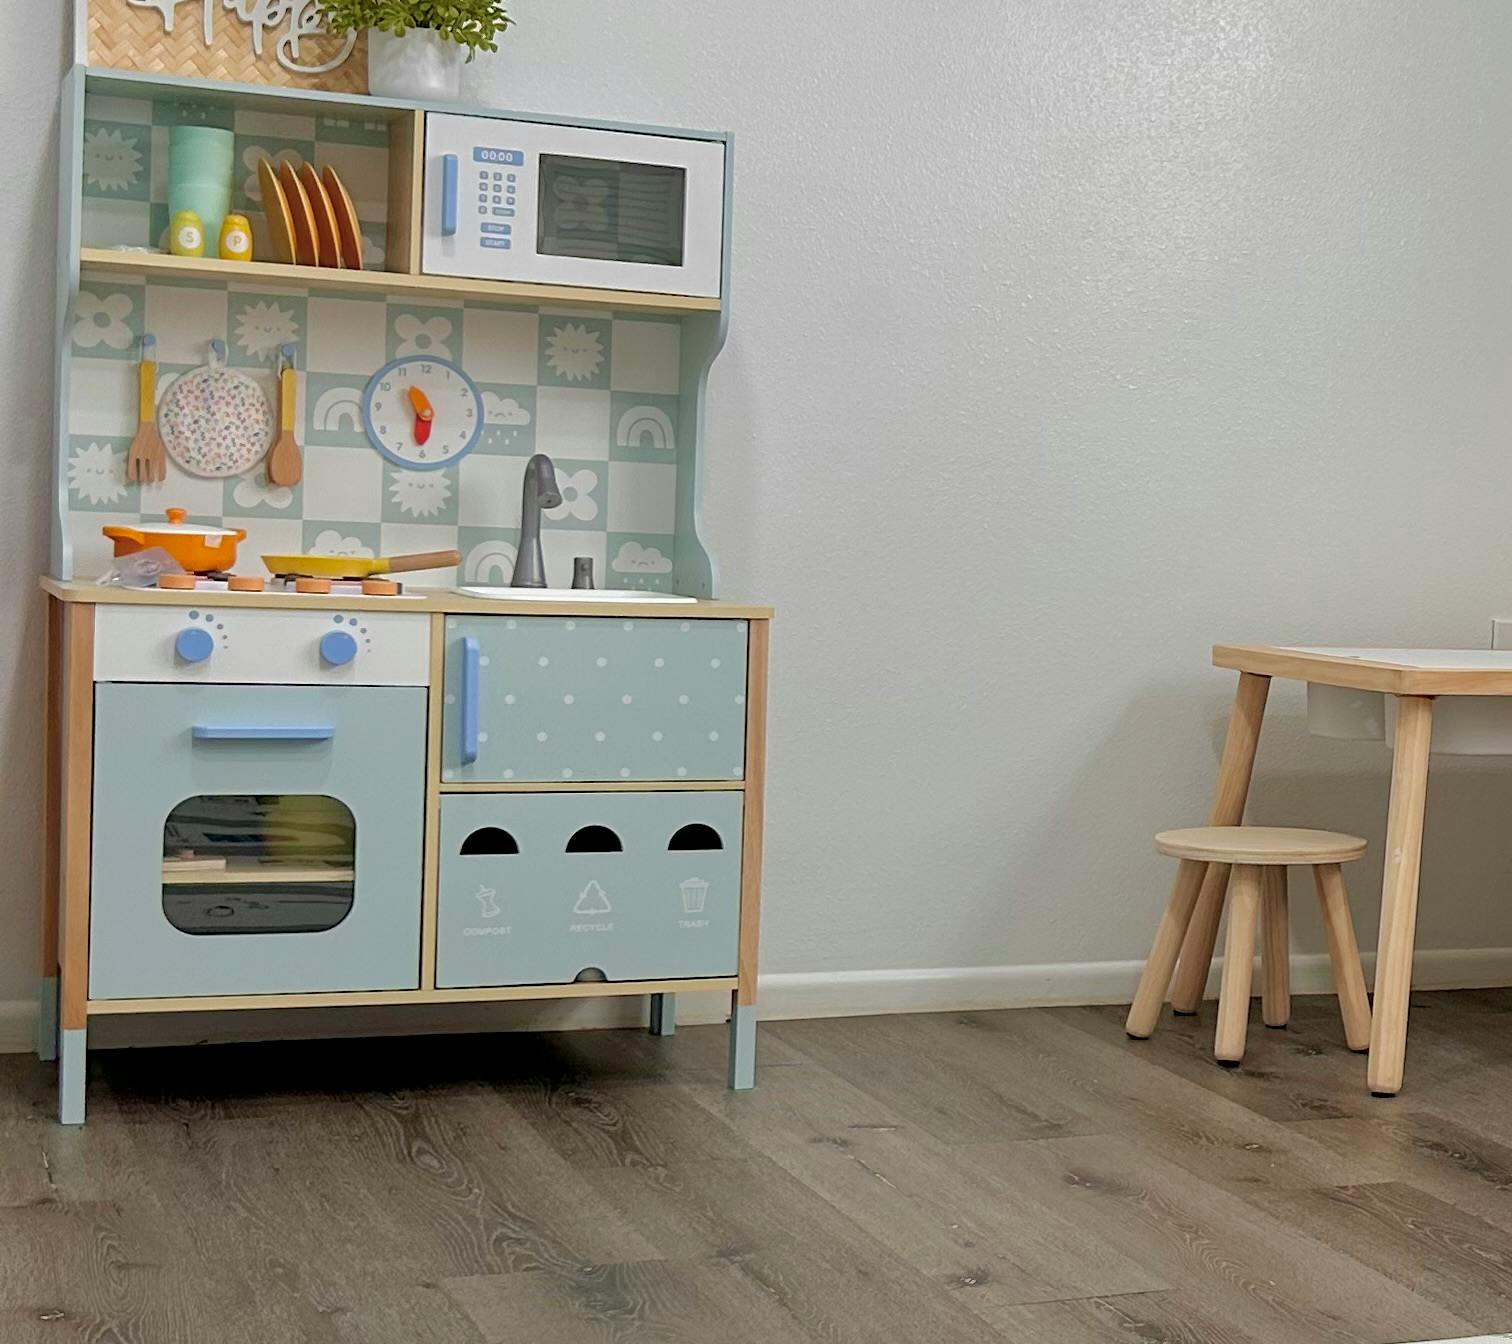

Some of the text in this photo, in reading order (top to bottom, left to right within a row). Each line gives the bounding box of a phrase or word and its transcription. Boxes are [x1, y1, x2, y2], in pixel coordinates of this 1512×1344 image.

[185, 231, 194, 243] S
[232, 235, 242, 247] P
[398, 367, 407, 377] 11
[421, 364, 432, 374] 12
[381, 382, 391, 392] 10
[461, 388, 468, 397] 2
[375, 401, 382, 411] 9
[465, 408, 473, 418] 3
[380, 425, 387, 435] 8
[459, 431, 466, 440] 4
[396, 442, 403, 451] 7
[443, 445, 449, 454] 5
[419, 450, 426, 459] 6
[569, 922, 614, 934] RECYCLE
[677, 919, 710, 930] TRASH
[463, 926, 512, 937] COMPOST
